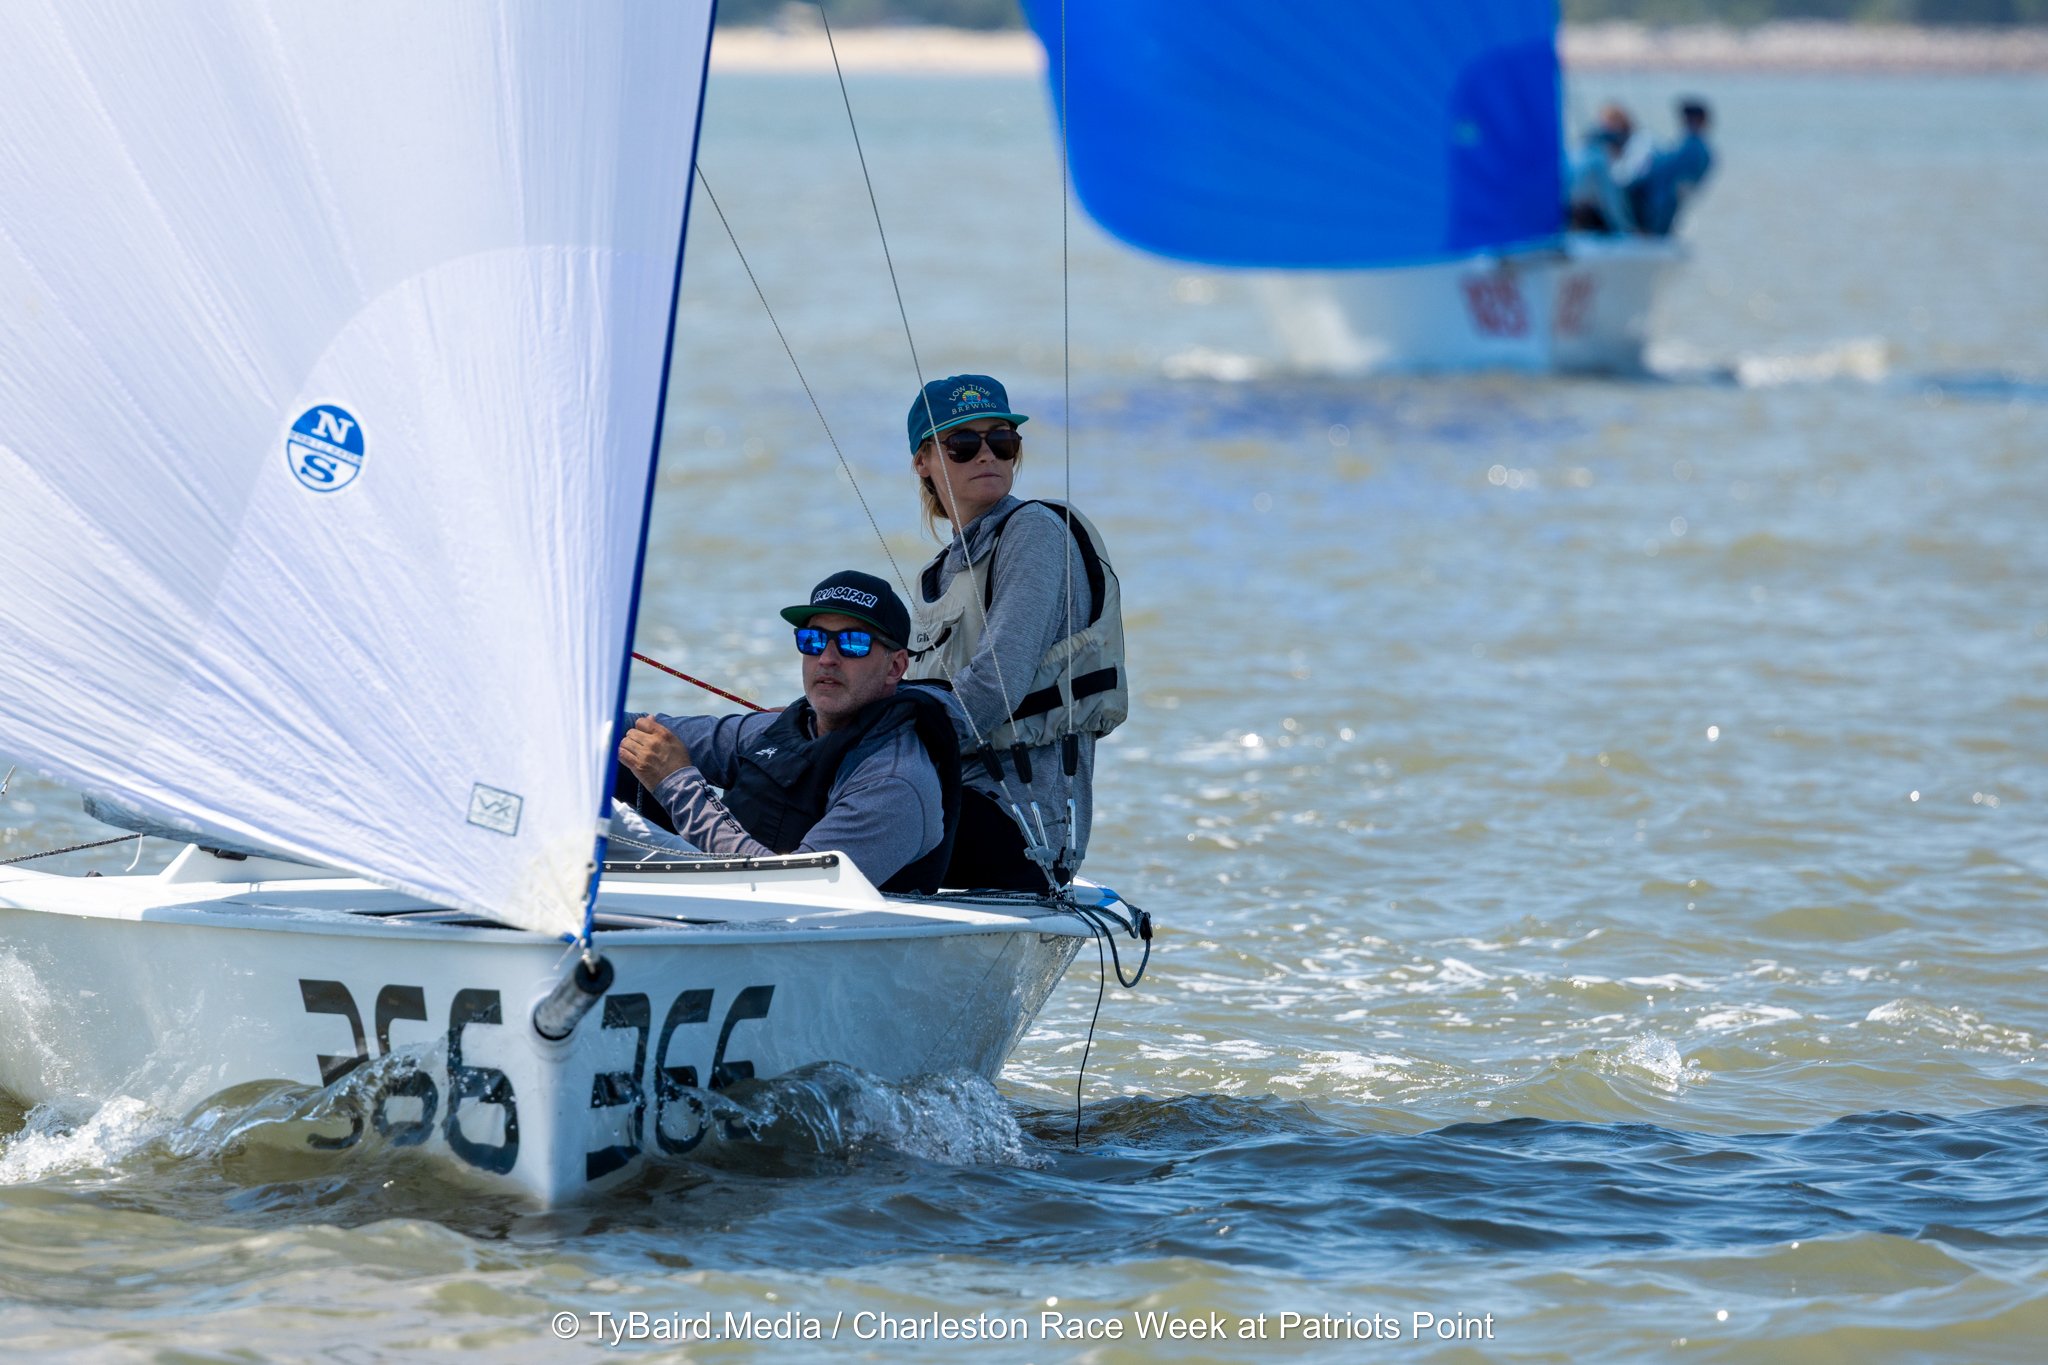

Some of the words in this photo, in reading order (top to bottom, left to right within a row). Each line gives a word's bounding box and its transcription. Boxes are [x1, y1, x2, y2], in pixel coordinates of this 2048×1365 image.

[949, 385, 966, 401] LOW
[967, 384, 991, 397] TIDE
[951, 402, 997, 415] BREWING
[311, 409, 355, 445] N
[300, 455, 336, 483] S
[831, 586, 878, 608] SAFARI
[298, 978, 520, 1175] 366
